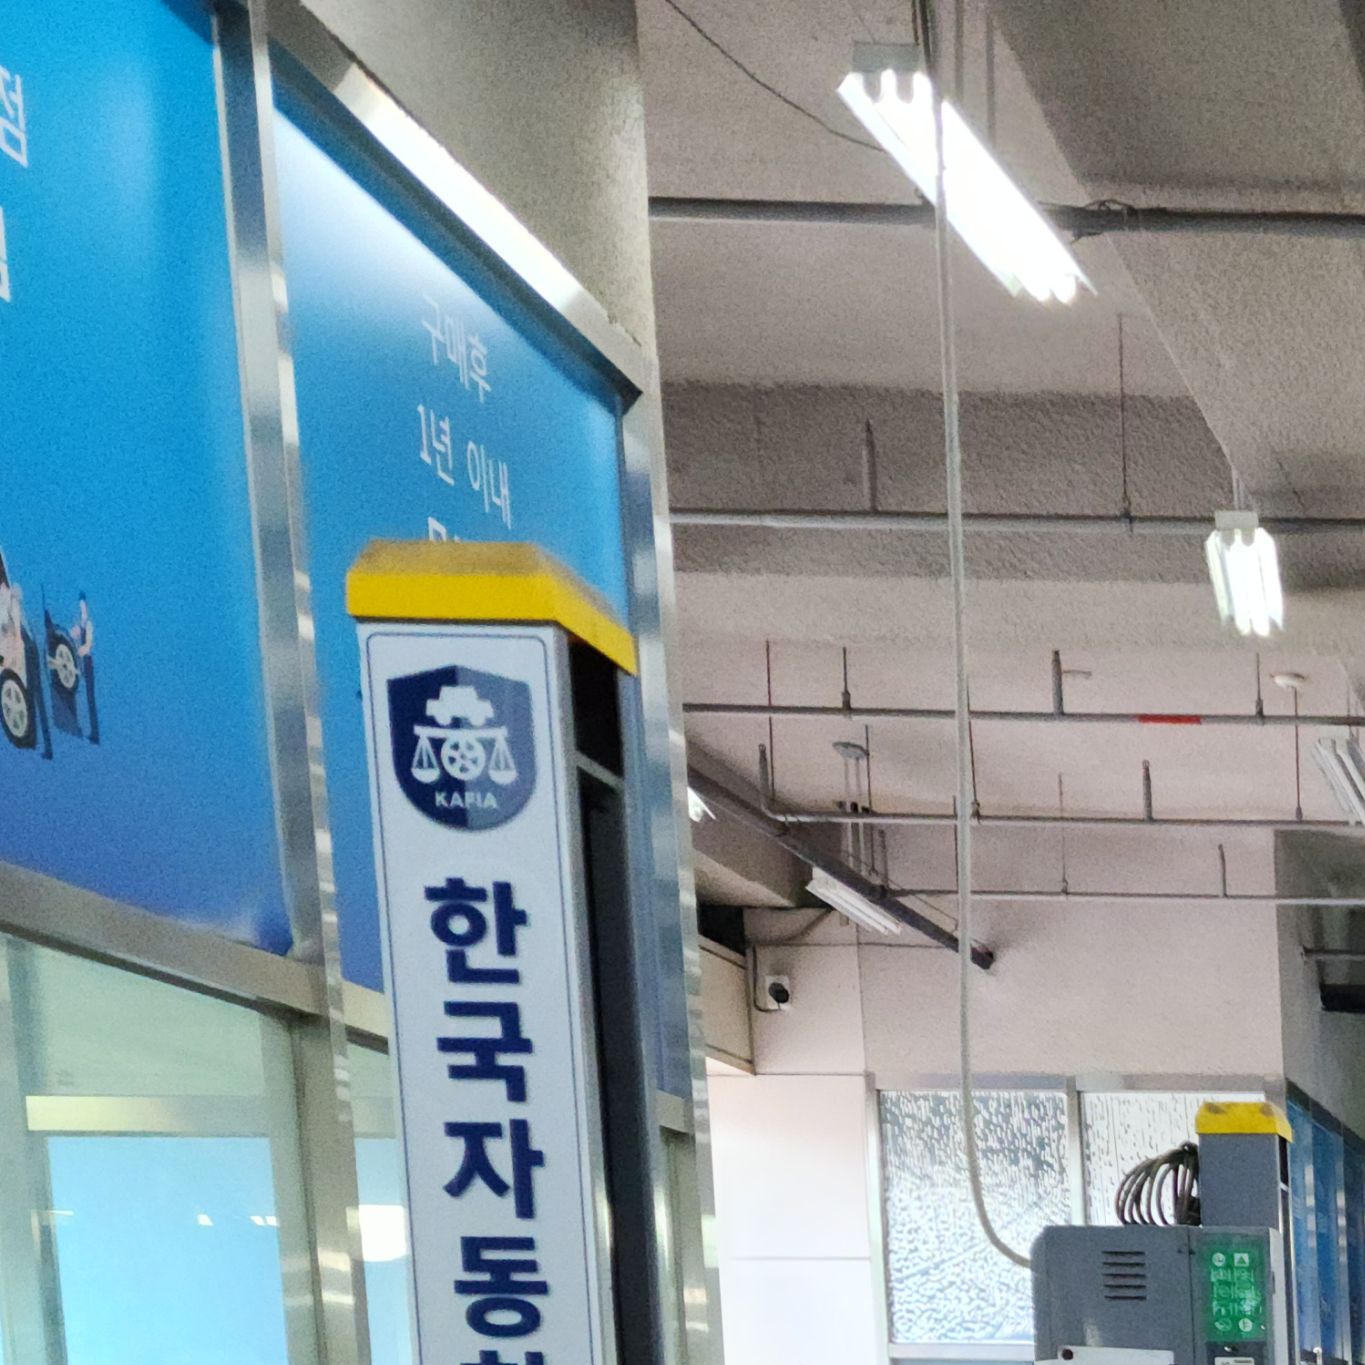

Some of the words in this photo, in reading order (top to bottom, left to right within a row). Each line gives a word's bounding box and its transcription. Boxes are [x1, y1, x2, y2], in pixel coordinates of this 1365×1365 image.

[421, 294, 492, 403] 구매후
[417, 404, 455, 485] 1년
[466, 440, 512, 530] 이내
